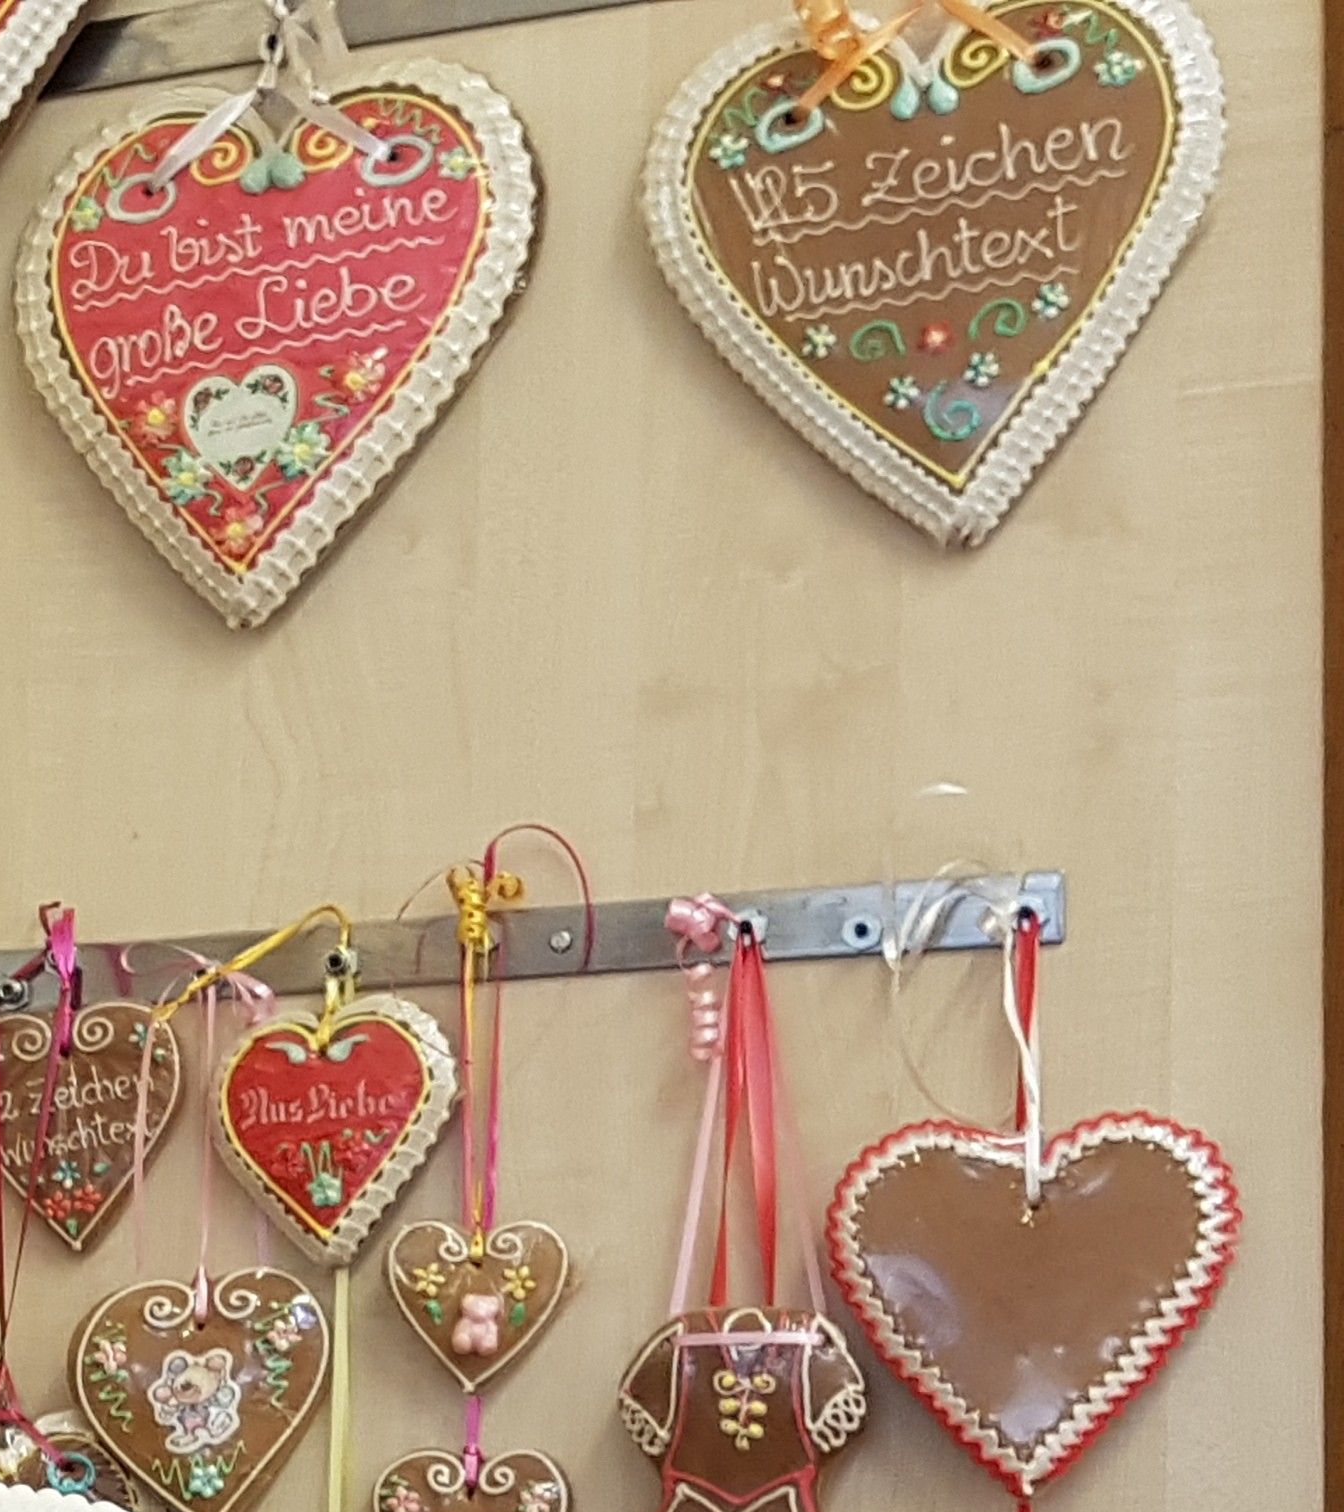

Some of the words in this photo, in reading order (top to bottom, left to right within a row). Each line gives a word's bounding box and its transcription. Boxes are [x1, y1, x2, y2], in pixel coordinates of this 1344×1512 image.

[862, 116, 1129, 205] Zeichen
[70, 240, 154, 300] Du
[161, 212, 263, 272] bist
[283, 187, 459, 248] meine
[752, 196, 1081, 317] Wunschtext
[89, 303, 224, 399] große
[235, 267, 427, 339] Liebe
